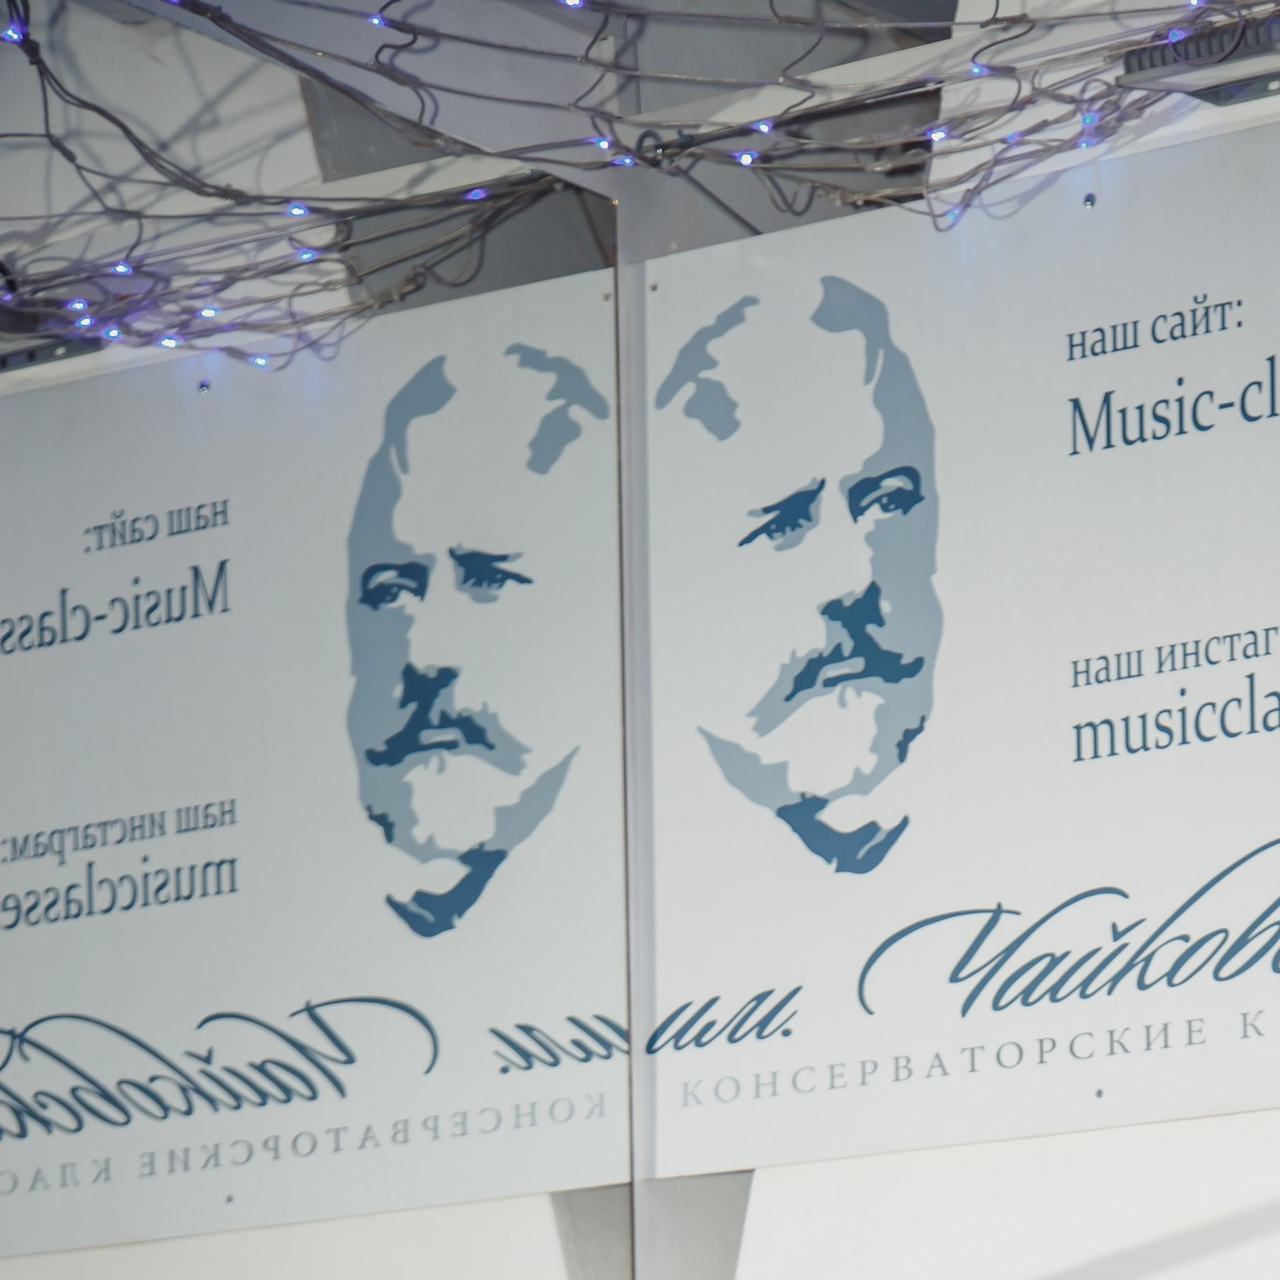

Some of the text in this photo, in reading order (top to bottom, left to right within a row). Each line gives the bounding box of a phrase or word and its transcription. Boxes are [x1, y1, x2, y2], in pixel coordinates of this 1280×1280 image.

[1066, 293, 1244, 362] наш сайт:
[1070, 649, 1145, 688] наш
[645, 985, 803, 1054] им.
[681, 1018, 1207, 1107] КОНСЕРВАТОРСКИЕ
